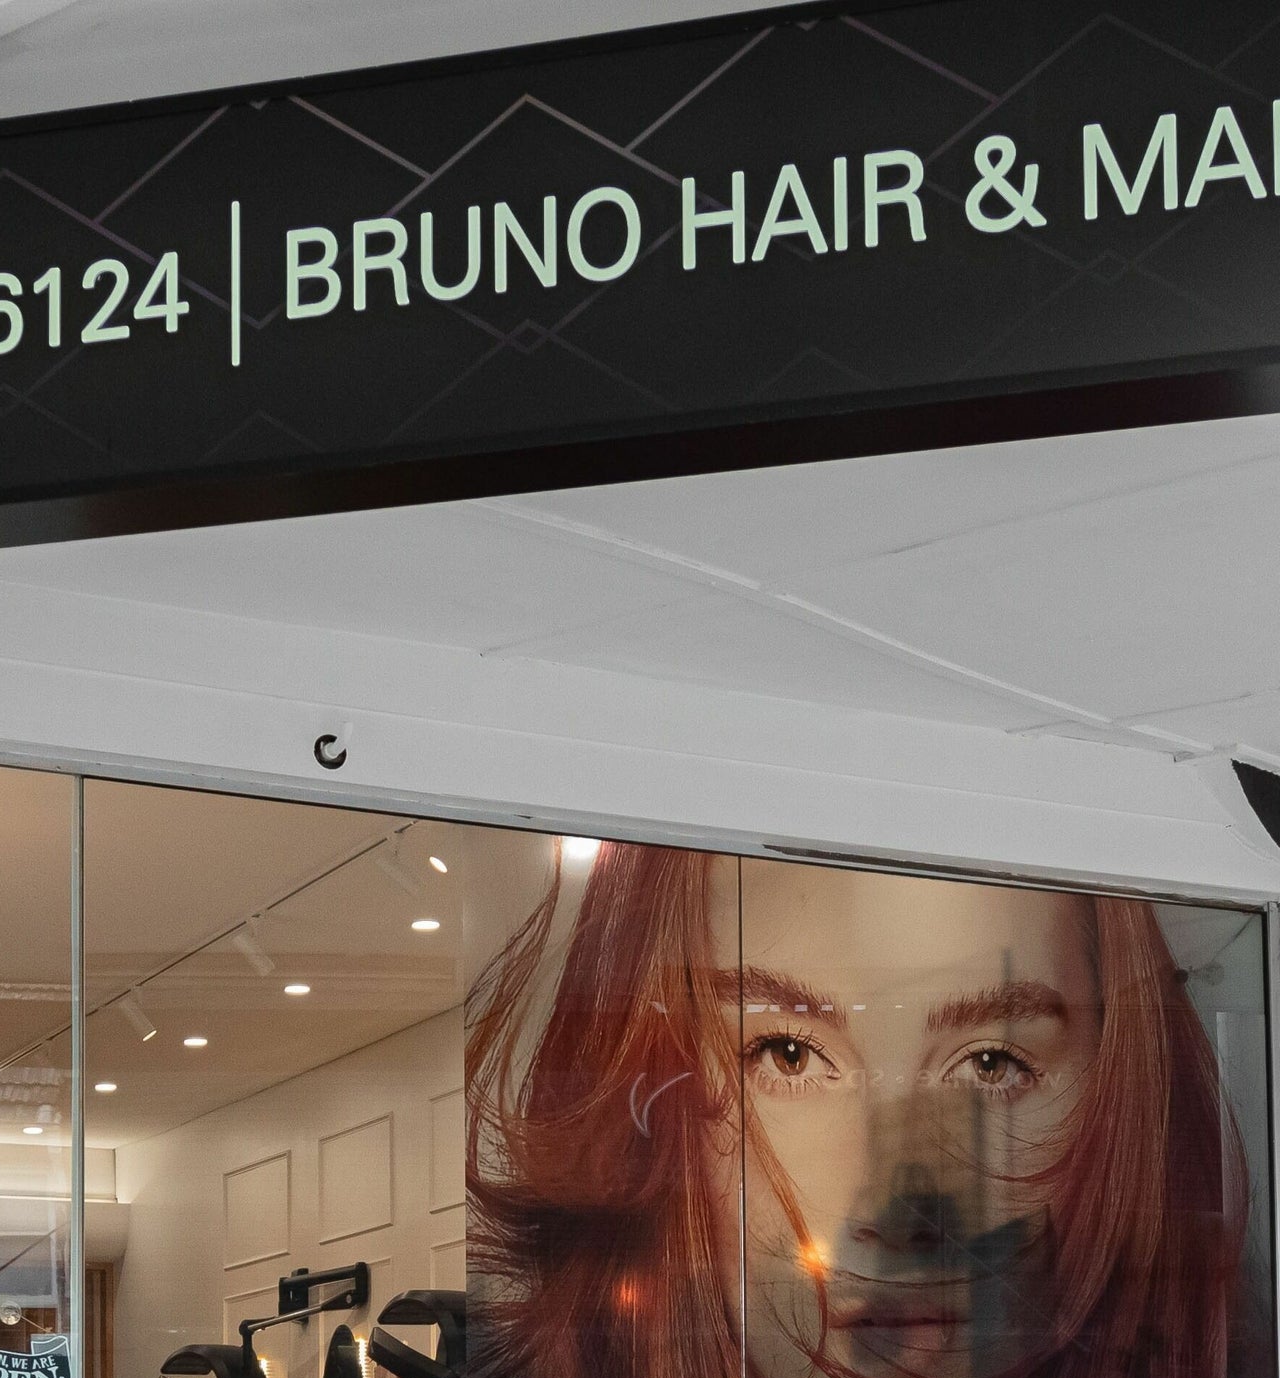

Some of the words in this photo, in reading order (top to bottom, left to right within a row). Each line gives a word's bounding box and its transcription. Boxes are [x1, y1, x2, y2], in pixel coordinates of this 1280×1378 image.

[286, 186, 642, 320] BRUNO
[681, 149, 927, 271] HAIR
[964, 134, 1048, 233] &
[11, 1357, 28, 1370] WE
[32, 1355, 56, 1370] ARE
